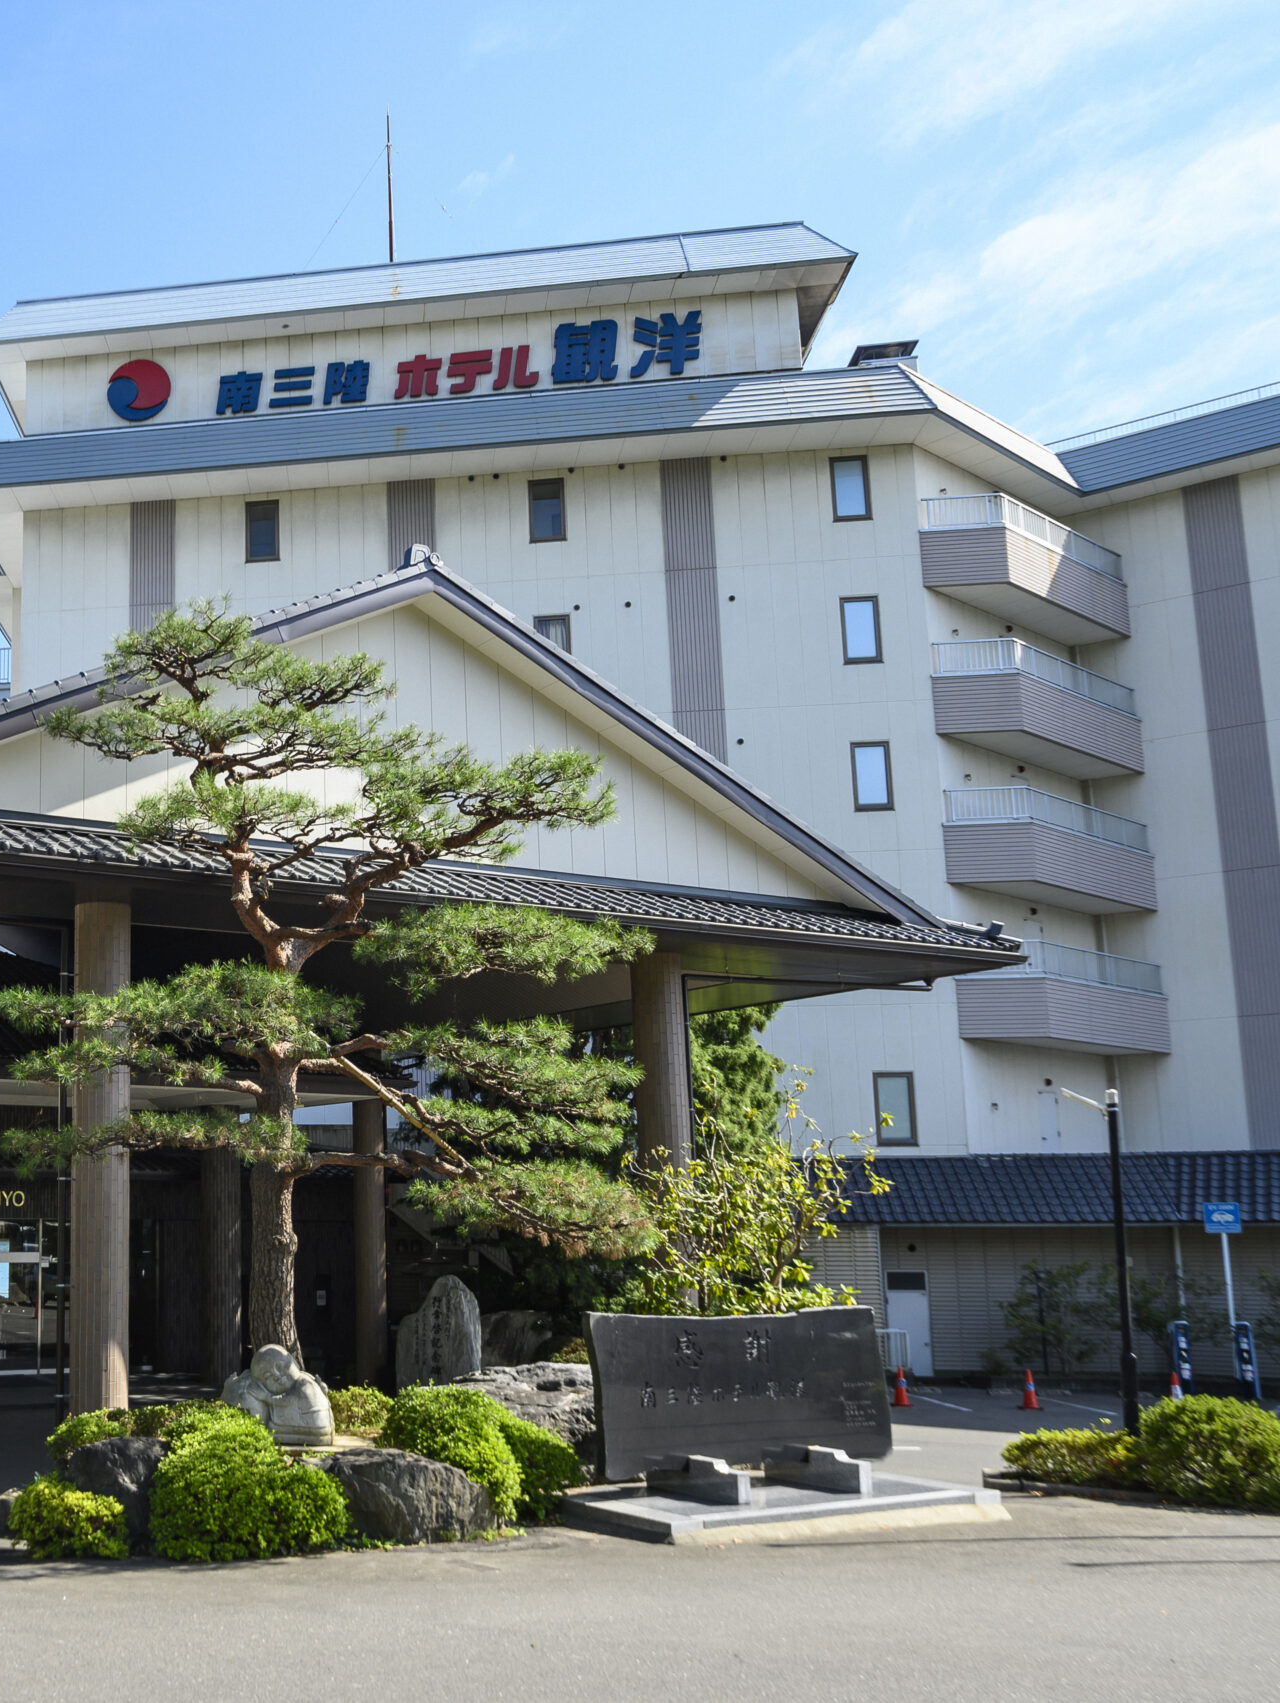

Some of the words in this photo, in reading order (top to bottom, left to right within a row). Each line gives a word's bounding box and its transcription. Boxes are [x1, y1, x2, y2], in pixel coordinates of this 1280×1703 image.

[216, 309, 703, 415] 南三陸ホテル観洋
